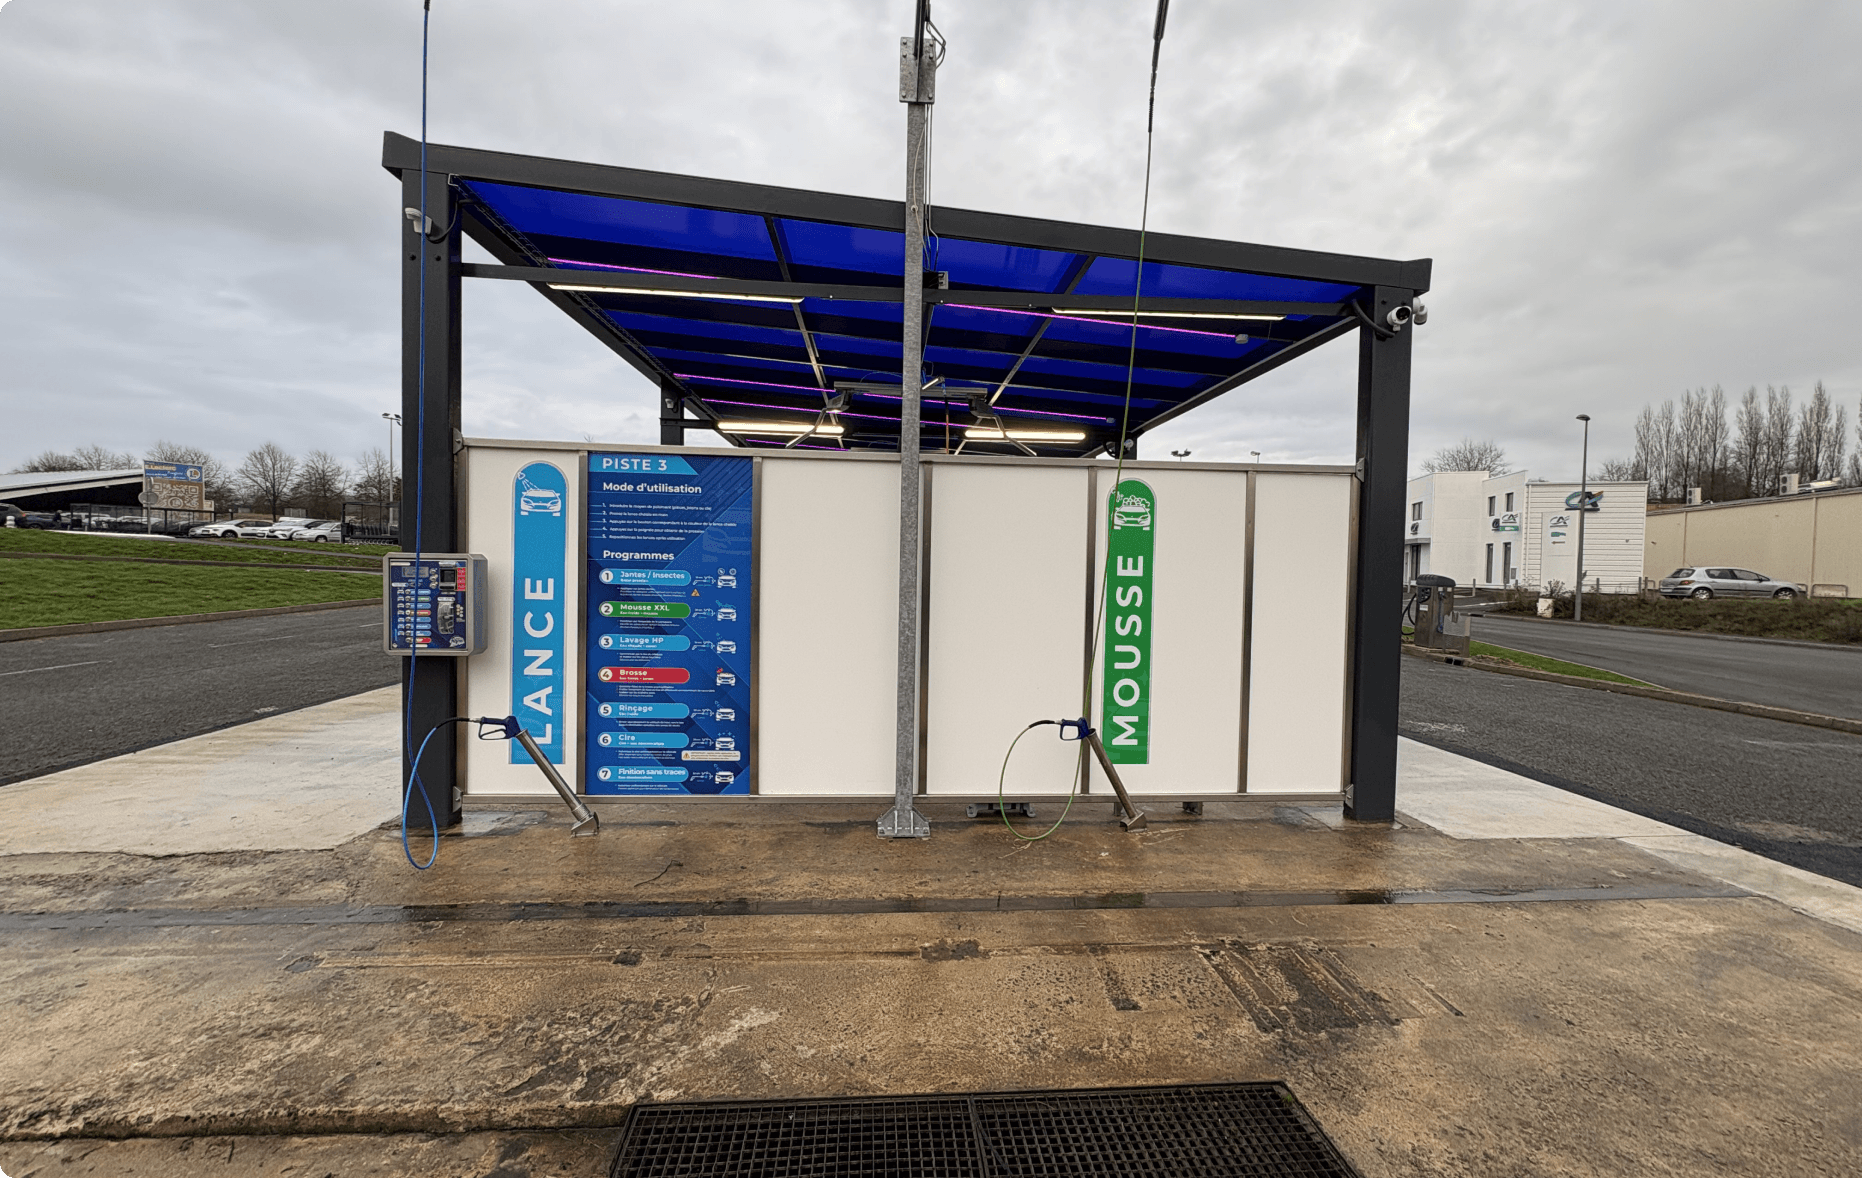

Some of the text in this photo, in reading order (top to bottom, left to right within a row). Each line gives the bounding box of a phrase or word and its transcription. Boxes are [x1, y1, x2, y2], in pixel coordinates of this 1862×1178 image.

[602, 457, 667, 471] PISTE 3
[603, 482, 702, 494] Mode d'utilisation
[603, 550, 675, 561] Programmes
[604, 572, 610, 581] 1
[620, 570, 646, 578] Jantes
[652, 571, 685, 579] Insectes
[604, 605, 610, 614] 2
[654, 604, 670, 612] XXL
[603, 637, 610, 647] 3
[620, 636, 650, 645] Lavage
[1111, 555, 1144, 746] MOUSSE
[523, 577, 554, 745] LANCE
[602, 670, 610, 678] 4
[602, 706, 609, 714] 5
[618, 704, 653, 713] Rinçage
[602, 736, 609, 744] 6
[618, 733, 636, 741] Cire
[602, 770, 608, 778] 7
[618, 767, 646, 775] Finition
